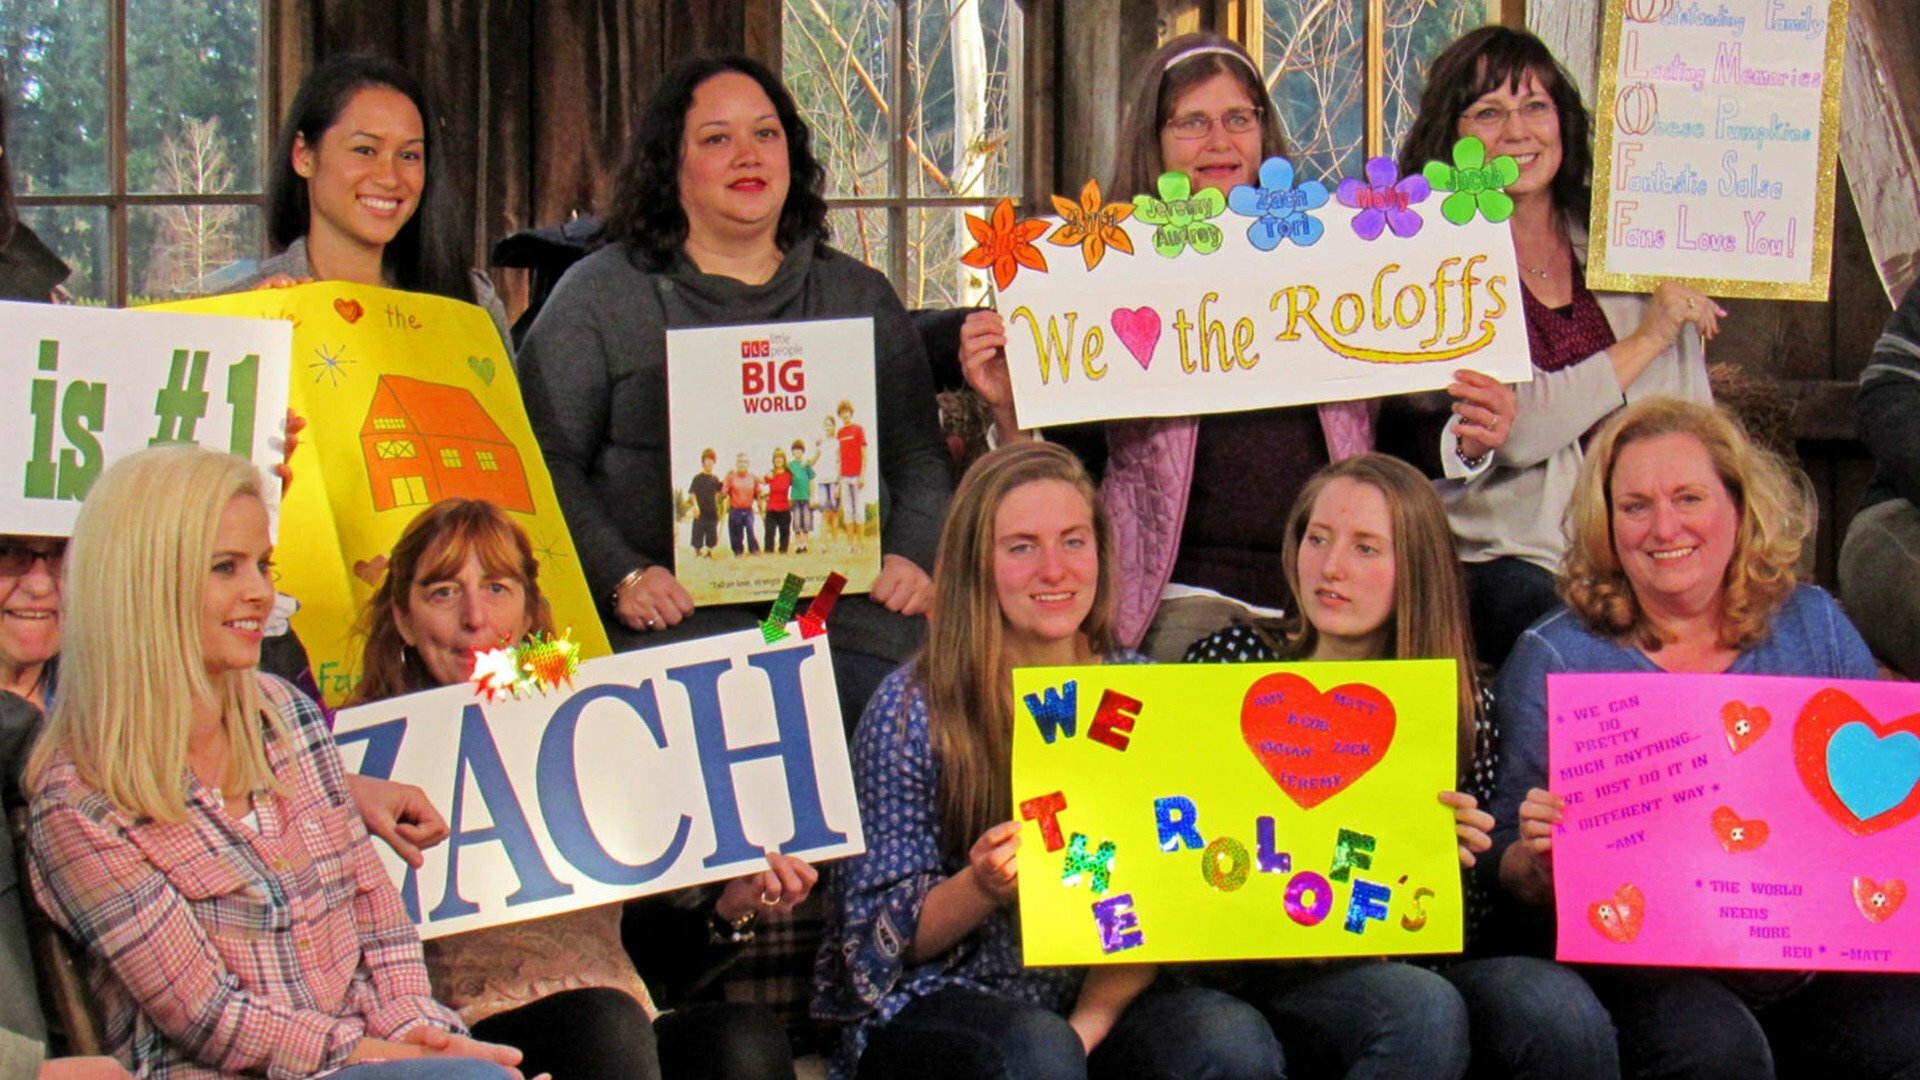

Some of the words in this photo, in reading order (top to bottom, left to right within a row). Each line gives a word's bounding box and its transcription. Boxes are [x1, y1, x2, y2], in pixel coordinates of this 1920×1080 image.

[1765, 0, 1825, 39] Family
[1624, 30, 1705, 91] Lasting
[1712, 42, 1822, 87] Memories
[1614, 82, 1705, 136] Obese
[1715, 97, 1812, 150] Pumpkins
[1616, 142, 1708, 195] Fantastic
[1718, 150, 1784, 199] Salsa
[1254, 187, 1309, 210] Zach
[1355, 187, 1409, 212] Molly
[1260, 212, 1310, 238] Tori
[1612, 200, 1666, 247] Fans
[1677, 204, 1736, 251] Love
[1743, 210, 1797, 258] You!
[385, 303, 422, 330] the
[1011, 306, 1109, 386] We
[1176, 292, 1261, 374] the
[1269, 254, 1508, 365] Roloffs
[742, 340, 770, 358] TLC
[742, 358, 805, 396] BIG
[743, 395, 807, 414] WORLD
[24, 339, 107, 502] is
[148, 348, 261, 464] #1
[319, 662, 362, 694] Fa
[1023, 680, 1144, 752] WE
[1573, 705, 1600, 721] WE
[1608, 695, 1640, 714] CAN
[1600, 717, 1620, 732] DO
[1575, 727, 1640, 753] PRETTY
[1560, 759, 1605, 781] MUCH
[1564, 791, 1584, 806] WE
[1639, 769, 1660, 786] DO
[1667, 762, 1683, 777] IT
[1692, 753, 1708, 770] IN
[1578, 798, 1664, 831] DIFFERENT
[1672, 784, 1705, 804] WAY
[1020, 790, 1145, 954] THE
[1709, 879, 1740, 894] THE
[1750, 881, 1803, 897] WORLD
[1719, 906, 1769, 921] NEEDS
[1749, 925, 1791, 940] MORE
[1782, 945, 1813, 960] RED
